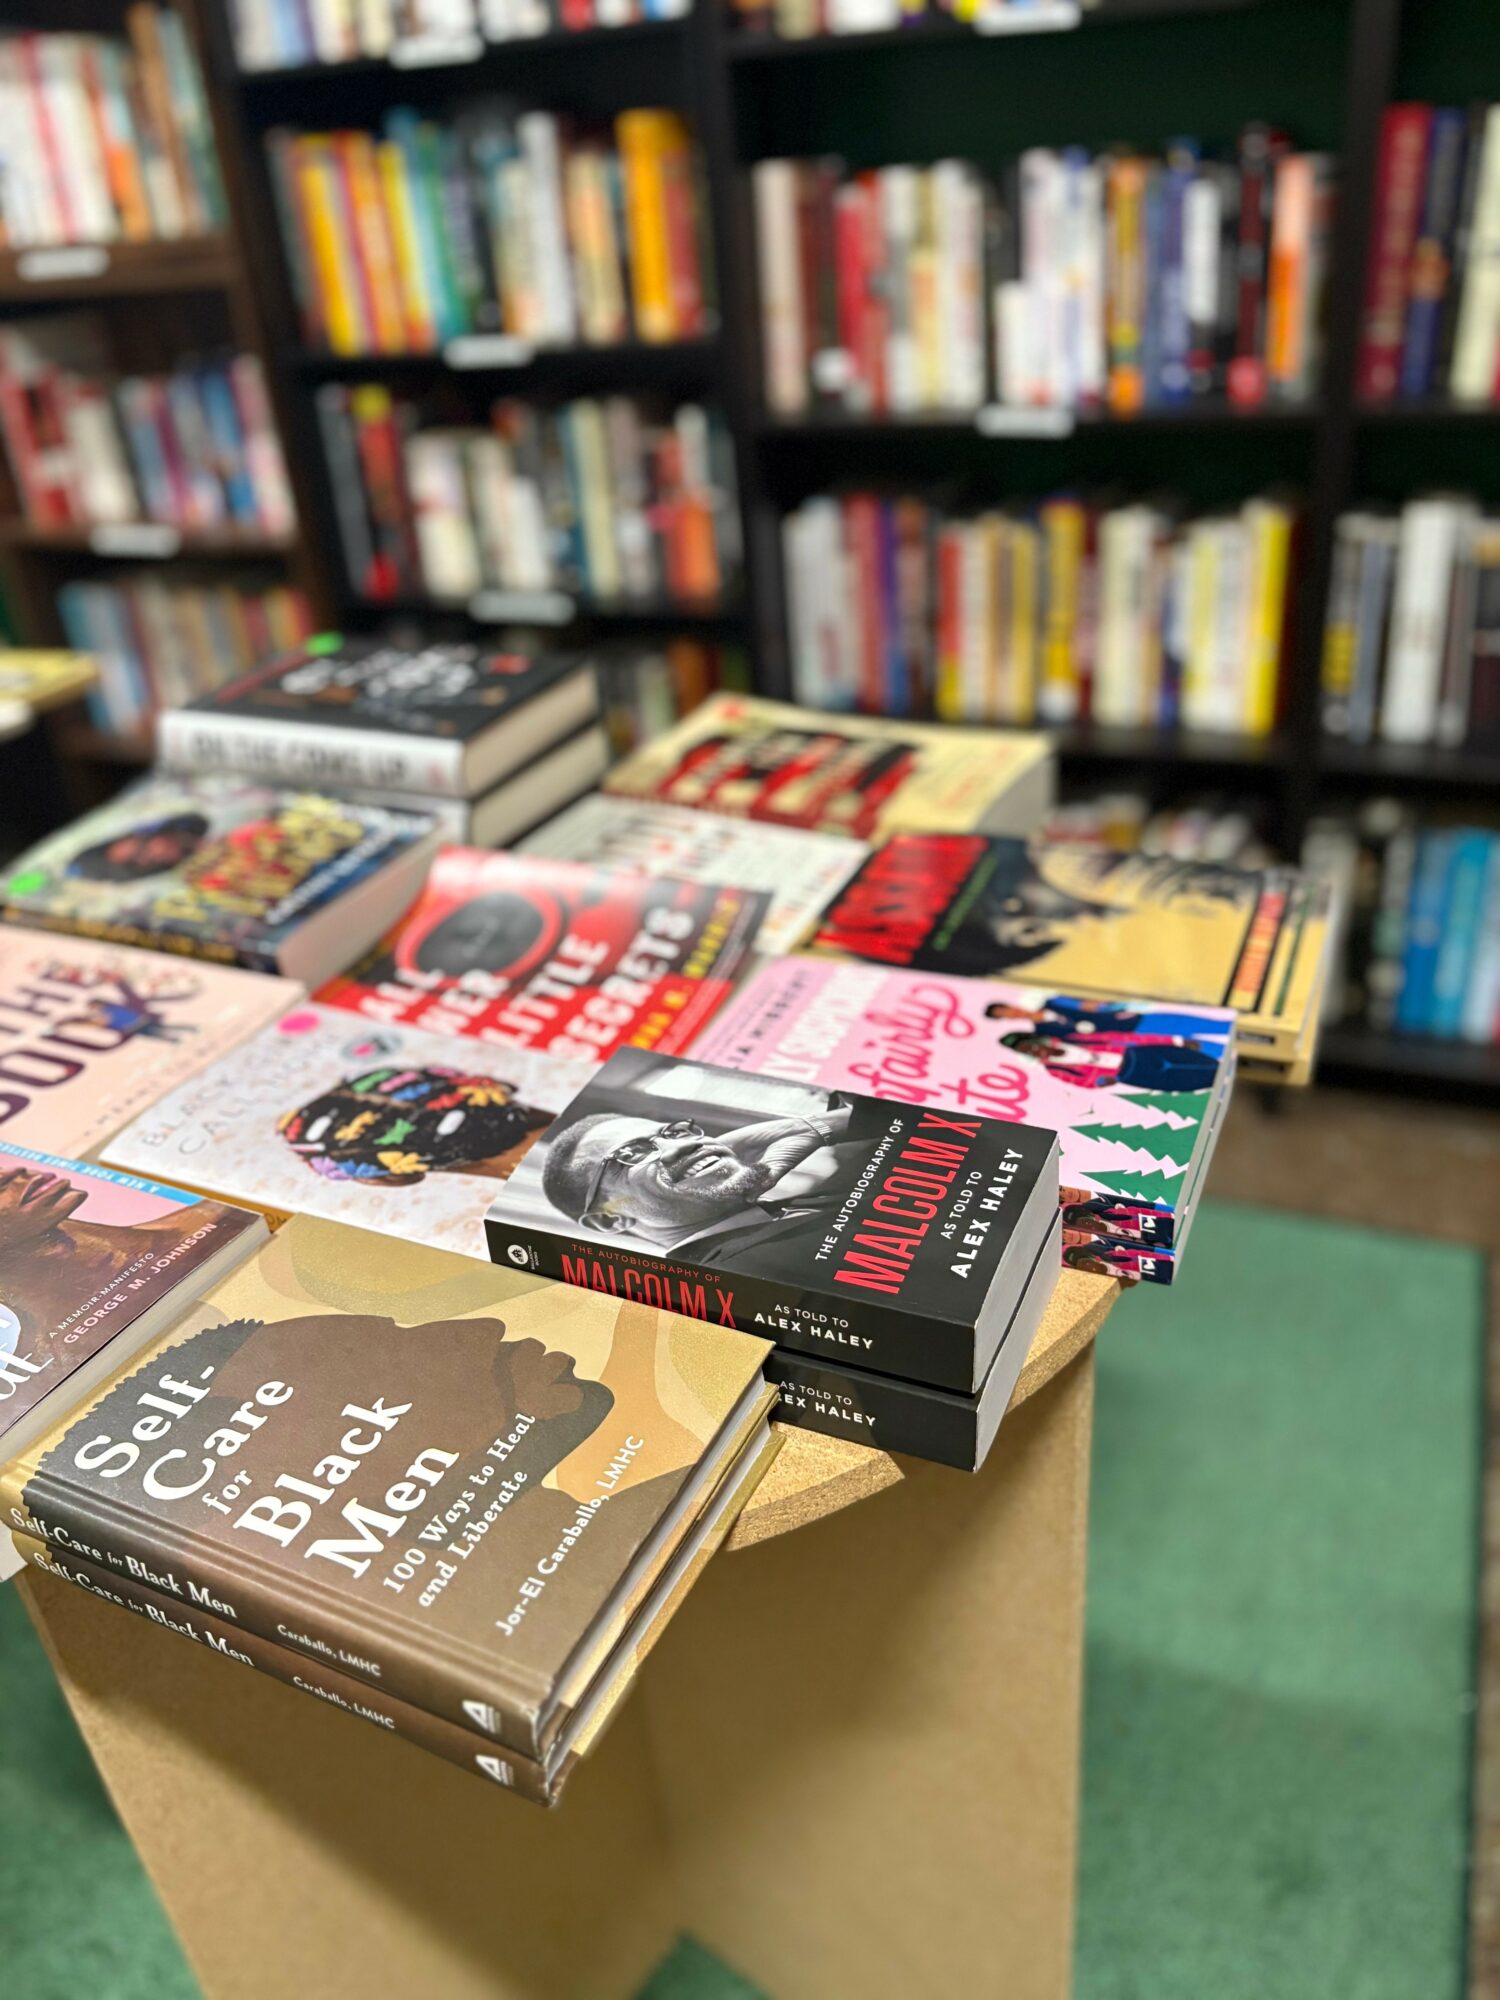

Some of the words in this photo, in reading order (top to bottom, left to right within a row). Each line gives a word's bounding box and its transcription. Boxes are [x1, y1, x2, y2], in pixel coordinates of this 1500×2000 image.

[360, 966, 444, 1020] ALL
[416, 969, 509, 1034] HER
[480, 936, 609, 1047] LITTLE
[547, 907, 695, 1062] SECRETS
[848, 982, 976, 1103] nfairly
[940, 1064, 1030, 1123] ute
[815, 1234, 838, 1262] THE
[832, 1134, 895, 1232] AUTOBIOGRAPHY
[889, 1118, 904, 1134] OF
[833, 1136, 970, 1295] MALCOLM
[917, 1112, 983, 1139] X
[940, 1221, 957, 1240] AS
[949, 1187, 973, 1226] TOLD
[965, 1171, 983, 1189] TO
[950, 1219, 992, 1279] ALEX
[979, 1148, 1024, 1211] HALEY
[48, 1331, 58, 1340] A
[57, 1252, 155, 1330] MEMOIR-MANIFESTO
[63, 1293, 128, 1344] GEORGE
[127, 1276, 152, 1290] M.
[153, 1223, 218, 1274] JOHNSON
[561, 1254, 708, 1322] MALCOLM
[716, 1289, 737, 1329] X
[571, 1243, 593, 1256] THE
[598, 1250, 700, 1279] AUTOBIOGRAPHY
[704, 1273, 721, 1284] OF
[774, 1304, 790, 1315] AS
[794, 1308, 828, 1323] TOLD
[832, 1317, 849, 1329] TO
[754, 1312, 802, 1333] ALEX
[810, 1325, 874, 1350] HALEY
[74, 1365, 215, 1478] Self-
[142, 1380, 294, 1500] Care
[777, 1392, 807, 1409] EX
[815, 1401, 876, 1427] HALEY
[779, 1380, 796, 1391] AS
[799, 1384, 832, 1400] TOLD
[836, 1394, 853, 1406] TO
[202, 1470, 252, 1515] for
[232, 1397, 413, 1548] Black
[303, 1448, 460, 1579] Men
[383, 1548, 427, 1594] 100
[418, 1489, 476, 1545] Ways
[469, 1465, 495, 1487] to
[487, 1412, 536, 1462] Heal
[10, 1507, 103, 1561] Self-Care
[107, 1551, 124, 1567] for
[125, 1555, 185, 1596] Black
[187, 1580, 238, 1619] Men
[418, 1560, 458, 1608] and
[448, 1470, 528, 1560] Liberate
[496, 1576, 546, 1637] Jor-El
[537, 1495, 610, 1575] Caraballo,
[596, 1435, 645, 1490] LMHC
[33, 1552, 125, 1607] Self-Care
[127, 1599, 144, 1613] for
[145, 1604, 203, 1644] Black
[205, 1631, 256, 1667] Men
[277, 1624, 338, 1659] Caraballo,
[339, 1649, 382, 1677] LMHC
[354, 1702, 396, 1729] LMHC
